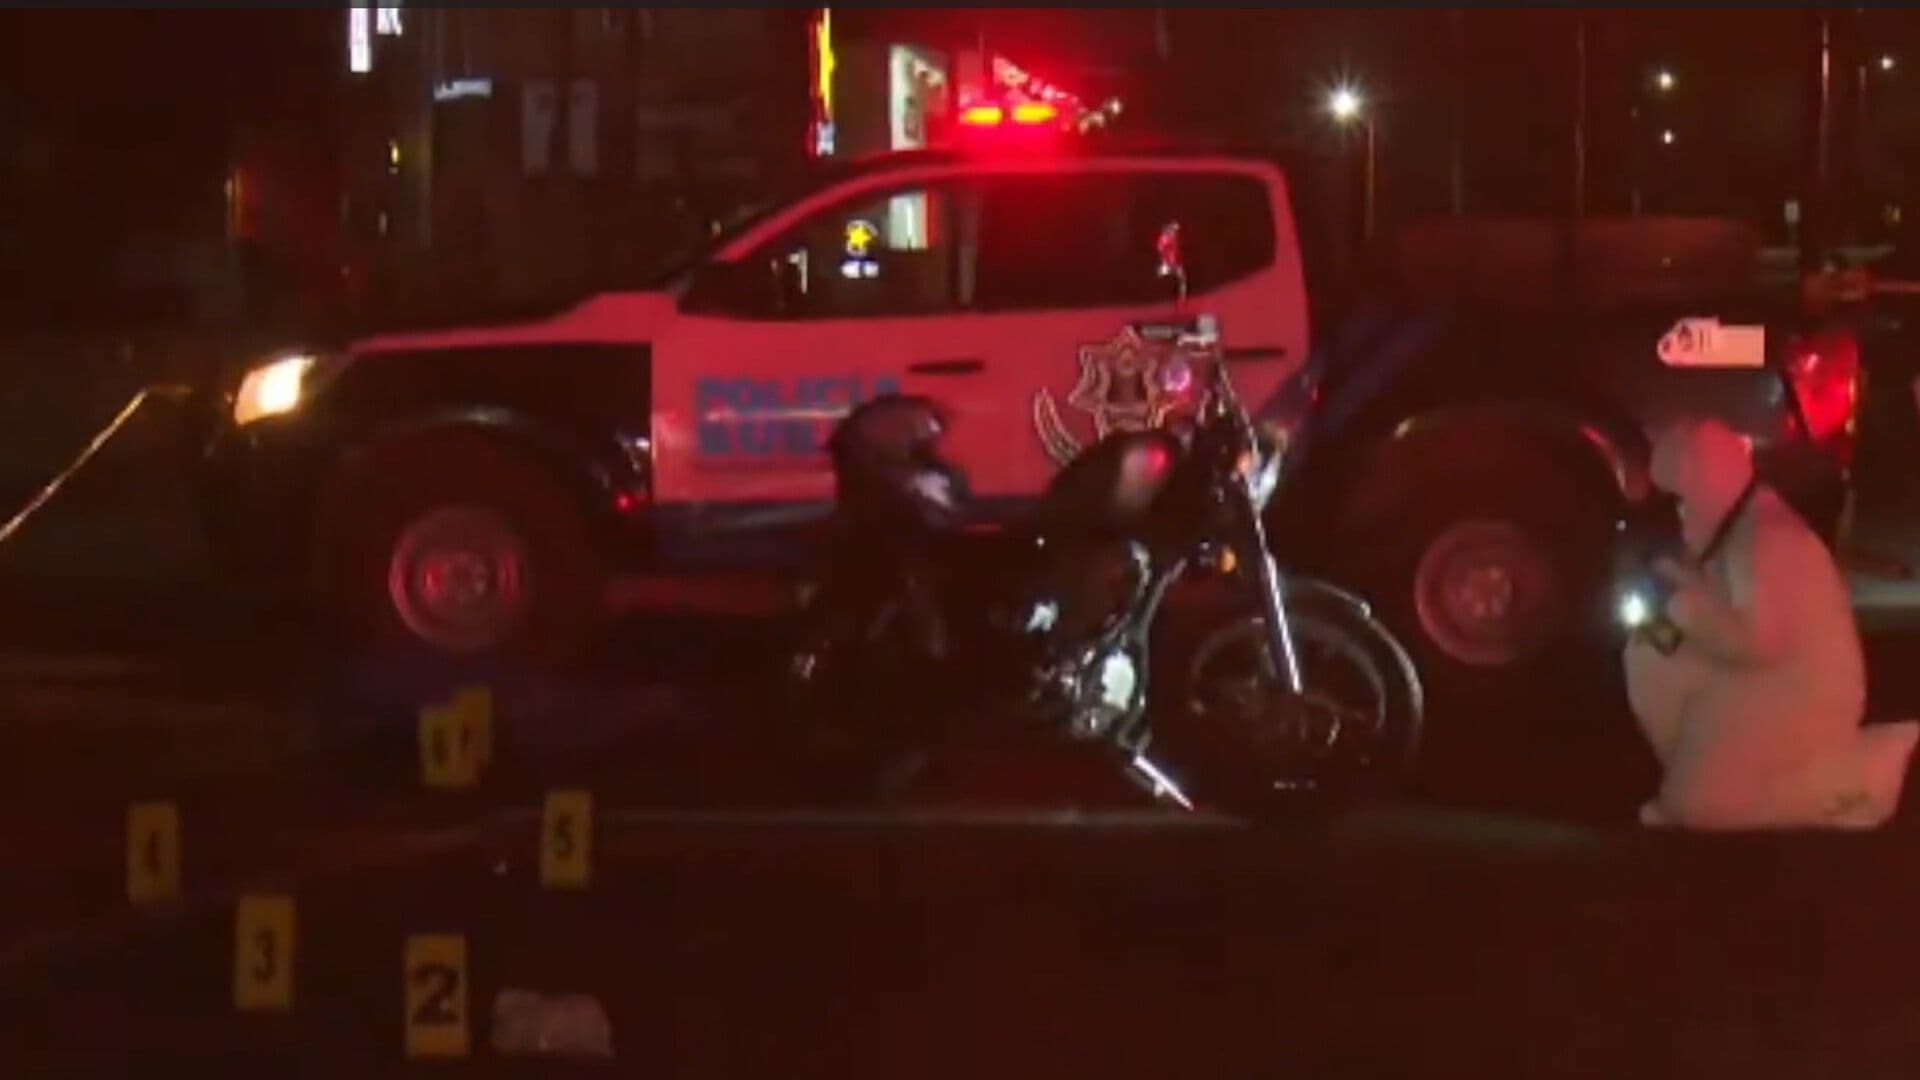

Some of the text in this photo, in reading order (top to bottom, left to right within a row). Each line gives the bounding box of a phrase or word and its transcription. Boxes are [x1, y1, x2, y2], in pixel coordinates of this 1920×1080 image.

[552, 814, 574, 861] 5
[253, 930, 277, 982] 3
[411, 963, 459, 1025] 2
